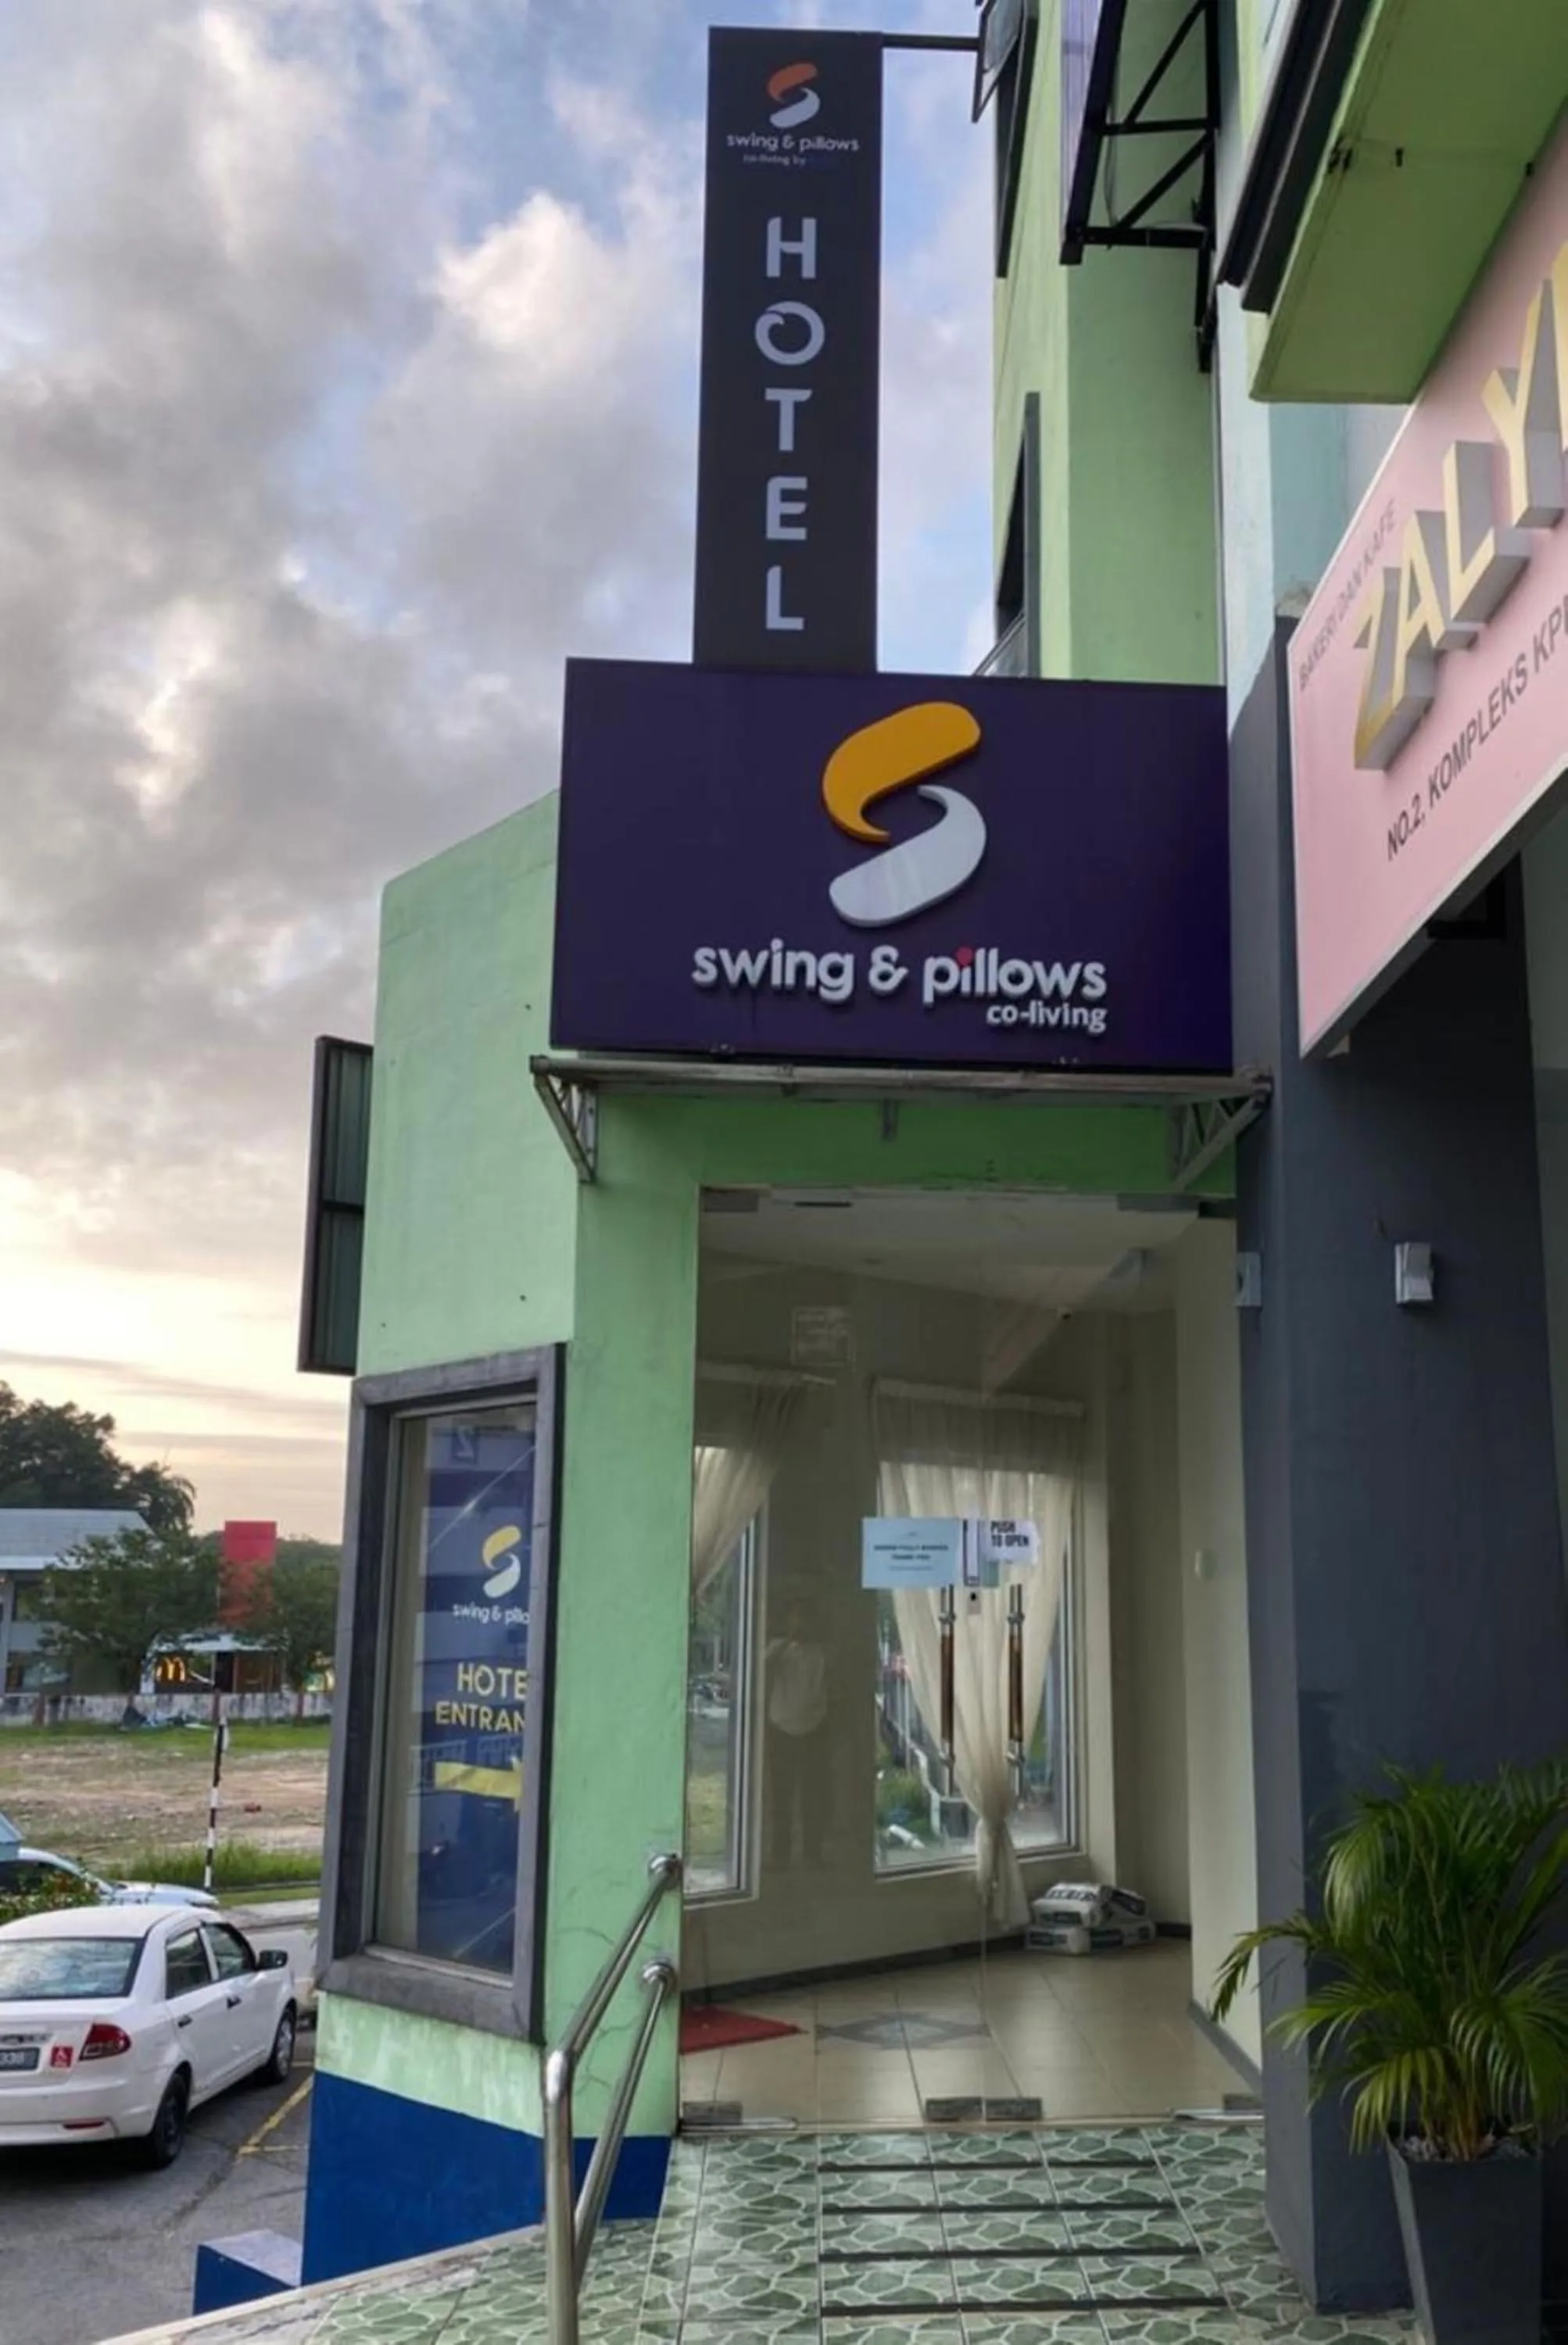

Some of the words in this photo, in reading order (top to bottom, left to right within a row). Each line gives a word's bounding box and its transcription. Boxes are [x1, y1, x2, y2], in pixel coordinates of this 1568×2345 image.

[725, 131, 779, 152] swing
[782, 134, 796, 149] &
[799, 135, 860, 153] pillows
[754, 217, 826, 630] HOTEL
[1353, 241, 1568, 770] ZALY
[1427, 652, 1527, 809] KOMPLEKS
[691, 937, 855, 1006] swing
[868, 944, 909, 996] &
[922, 945, 1108, 1008] pillows
[986, 1000, 1108, 1034] co-living
[1005, 1534, 1030, 1548] OPEN
[453, 1601, 491, 1624] swing
[491, 1605, 502, 1622] &
[504, 1606, 531, 1625] pillo
[456, 1661, 529, 1701] HOTE
[435, 1699, 526, 1735] ENTRAN
